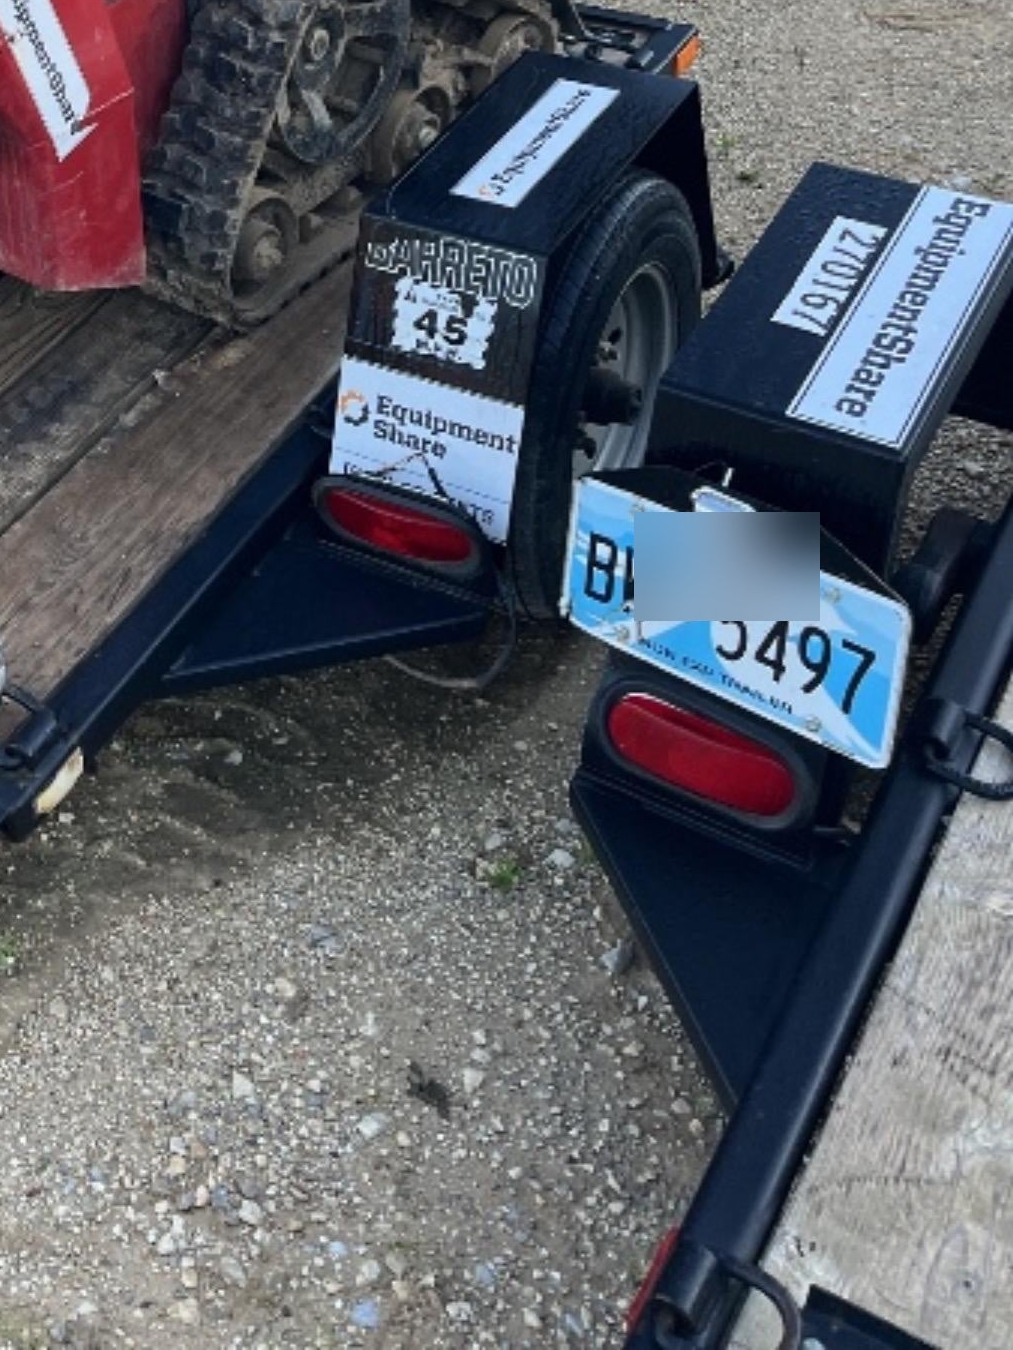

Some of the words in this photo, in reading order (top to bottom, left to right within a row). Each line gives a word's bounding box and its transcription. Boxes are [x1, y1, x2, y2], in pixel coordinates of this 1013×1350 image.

[835, 198, 991, 418] EquipmentShare
[373, 419, 447, 460] Share
[375, 394, 516, 454] Equipment
